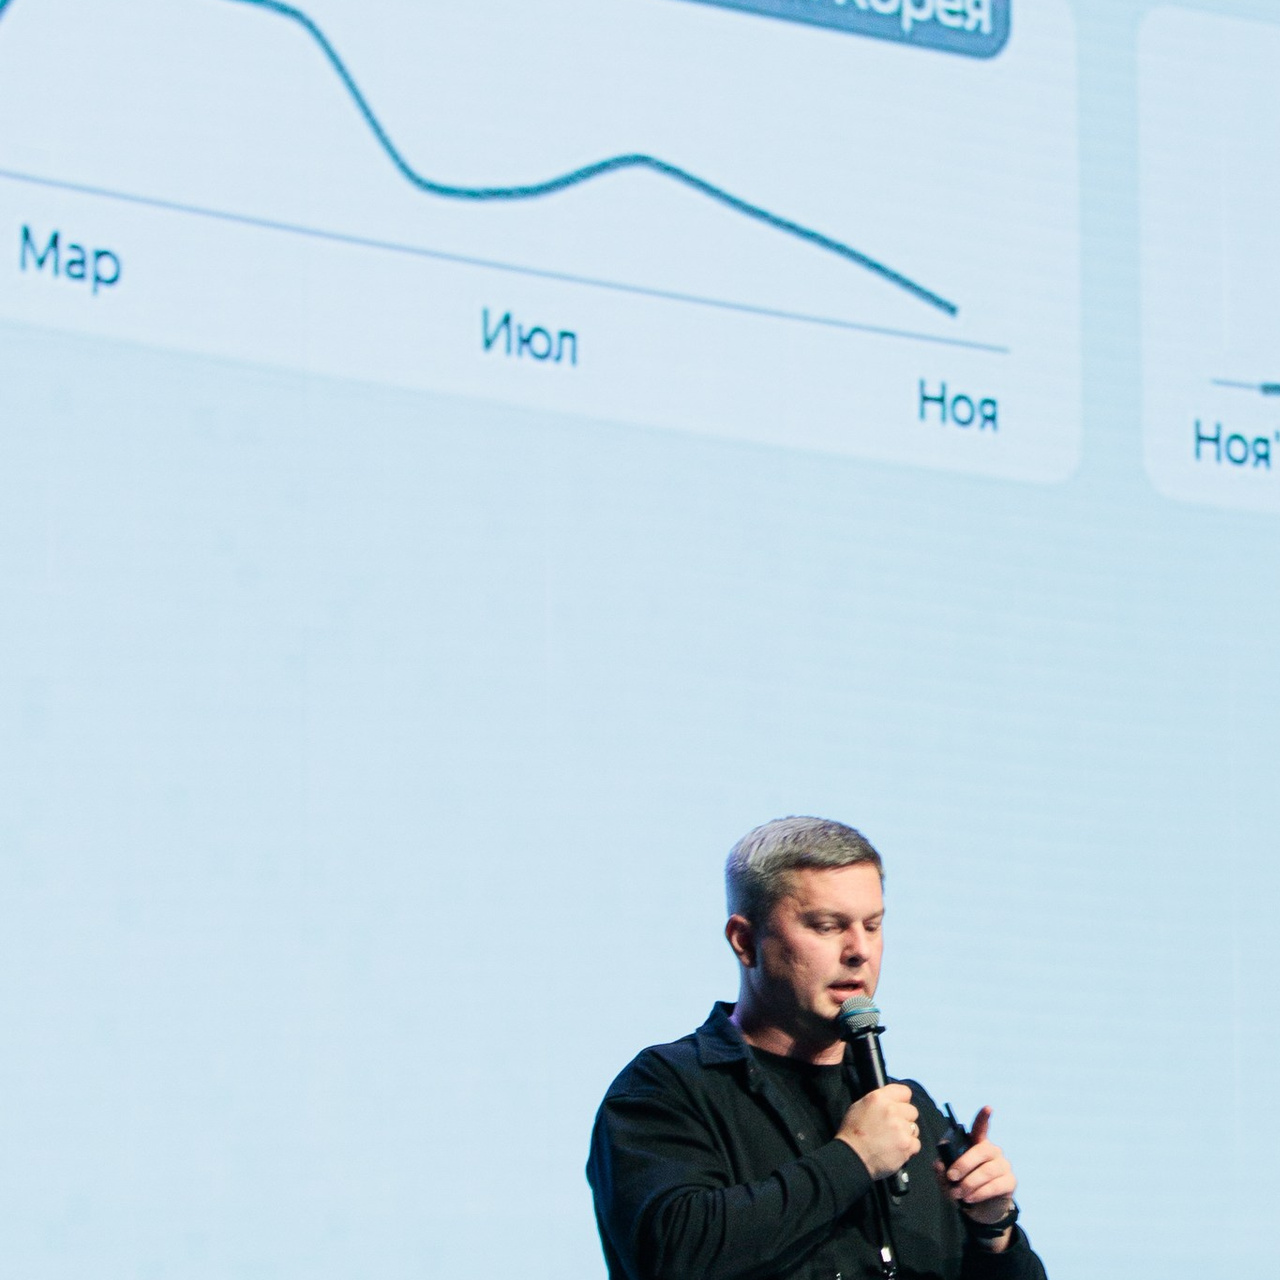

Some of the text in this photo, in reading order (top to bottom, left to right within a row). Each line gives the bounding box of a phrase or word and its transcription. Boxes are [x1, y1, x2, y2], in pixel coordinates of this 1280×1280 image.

[20, 223, 999, 432] Мар Июл Ноя
